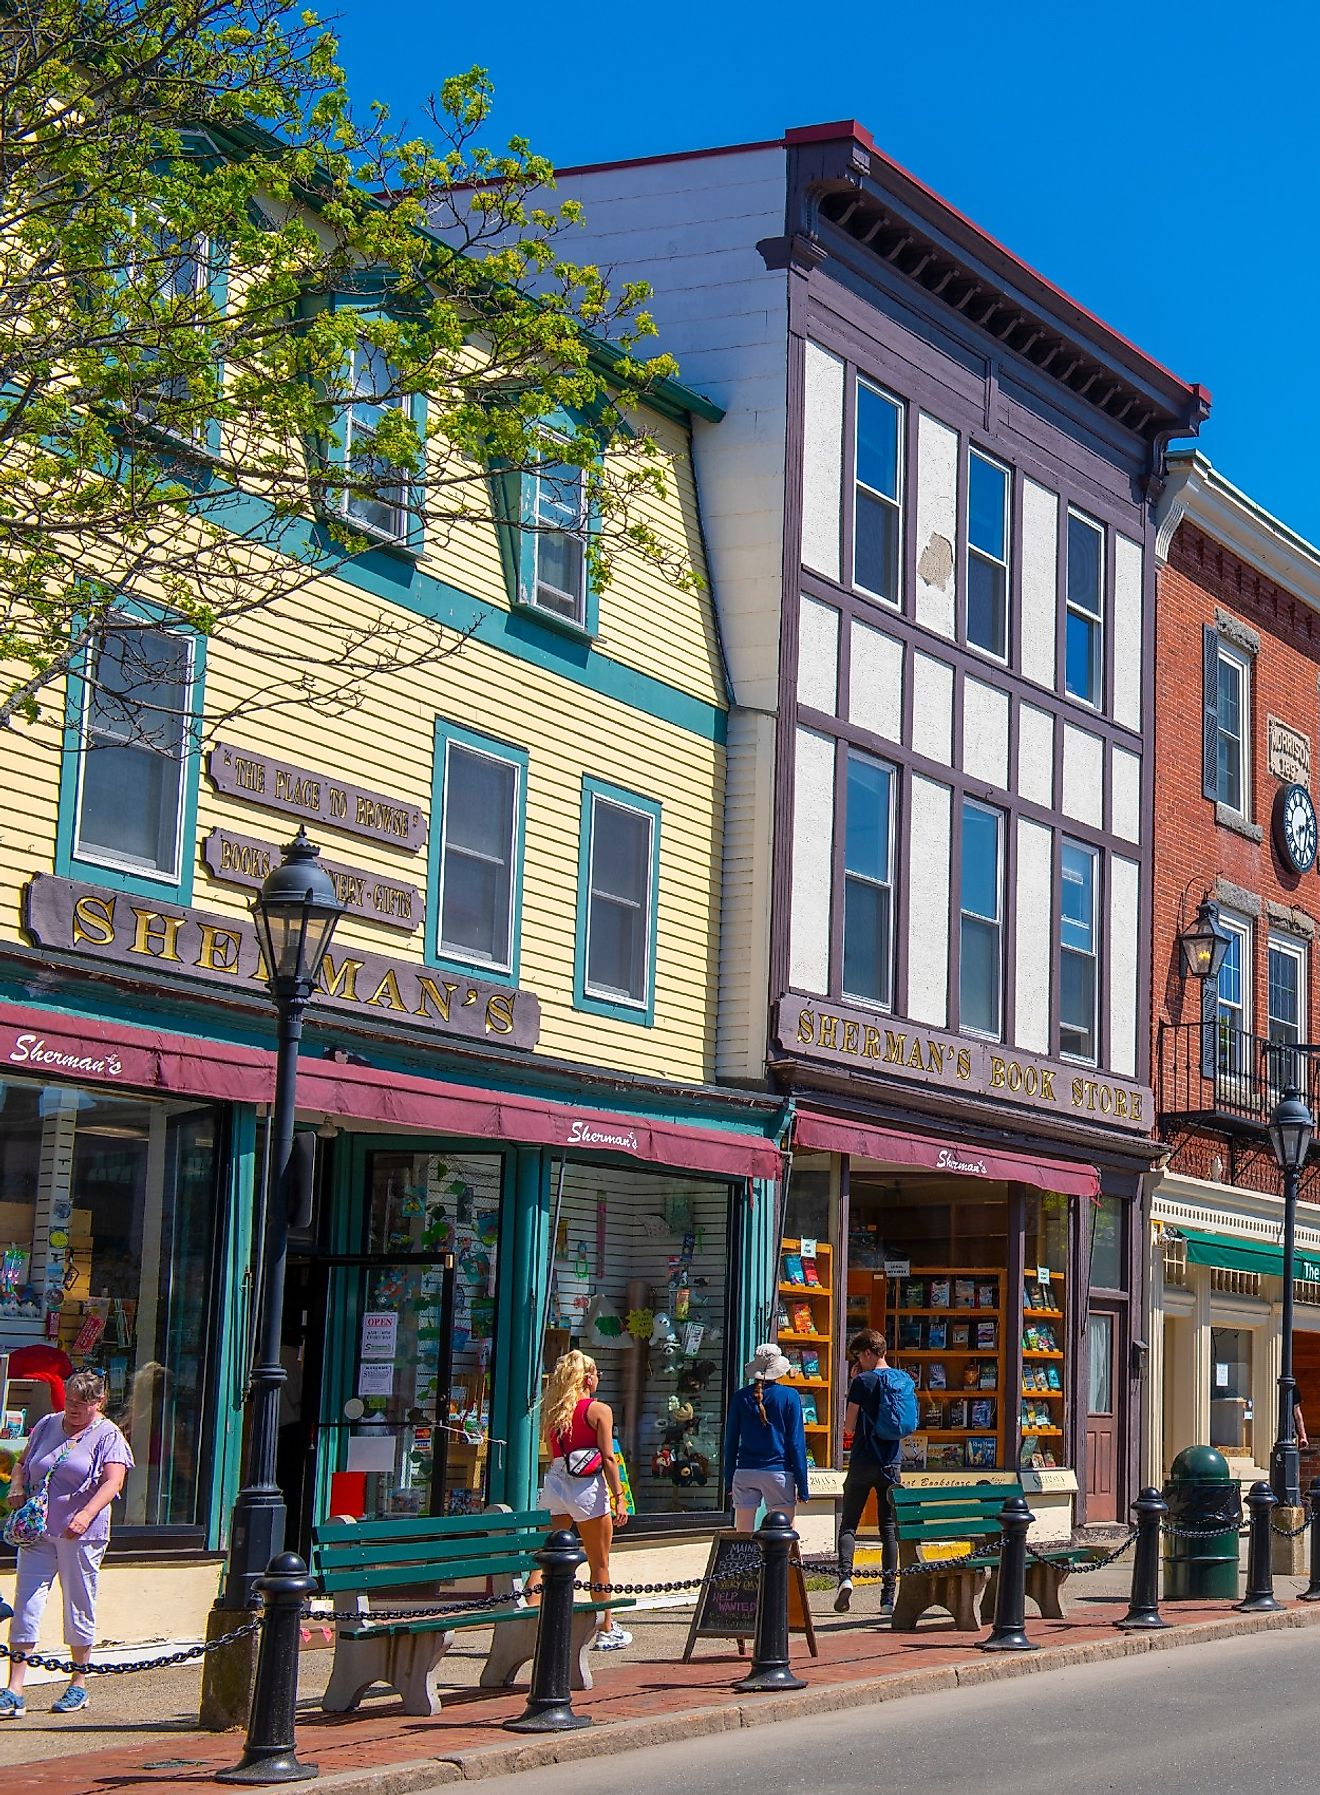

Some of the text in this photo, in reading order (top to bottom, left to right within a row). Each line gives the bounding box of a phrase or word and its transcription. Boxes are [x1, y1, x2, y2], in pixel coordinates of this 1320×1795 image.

[275, 769, 320, 812] PLACE
[329, 787, 347, 819] TO
[220, 839, 271, 879] BOOKS
[372, 884, 412, 919] GIFTS
[9, 1034, 123, 1075] Sherman's
[797, 1009, 1144, 1121] SHERMAN'S BOOK STORE
[567, 1121, 639, 1150] Sherman's
[936, 1150, 988, 1174] Sherman's
[1303, 1261, 1320, 1280] The
[367, 1317, 392, 1326] OPEN
[713, 1591, 738, 1602] HELP
[719, 1601, 757, 1613] WANTED
